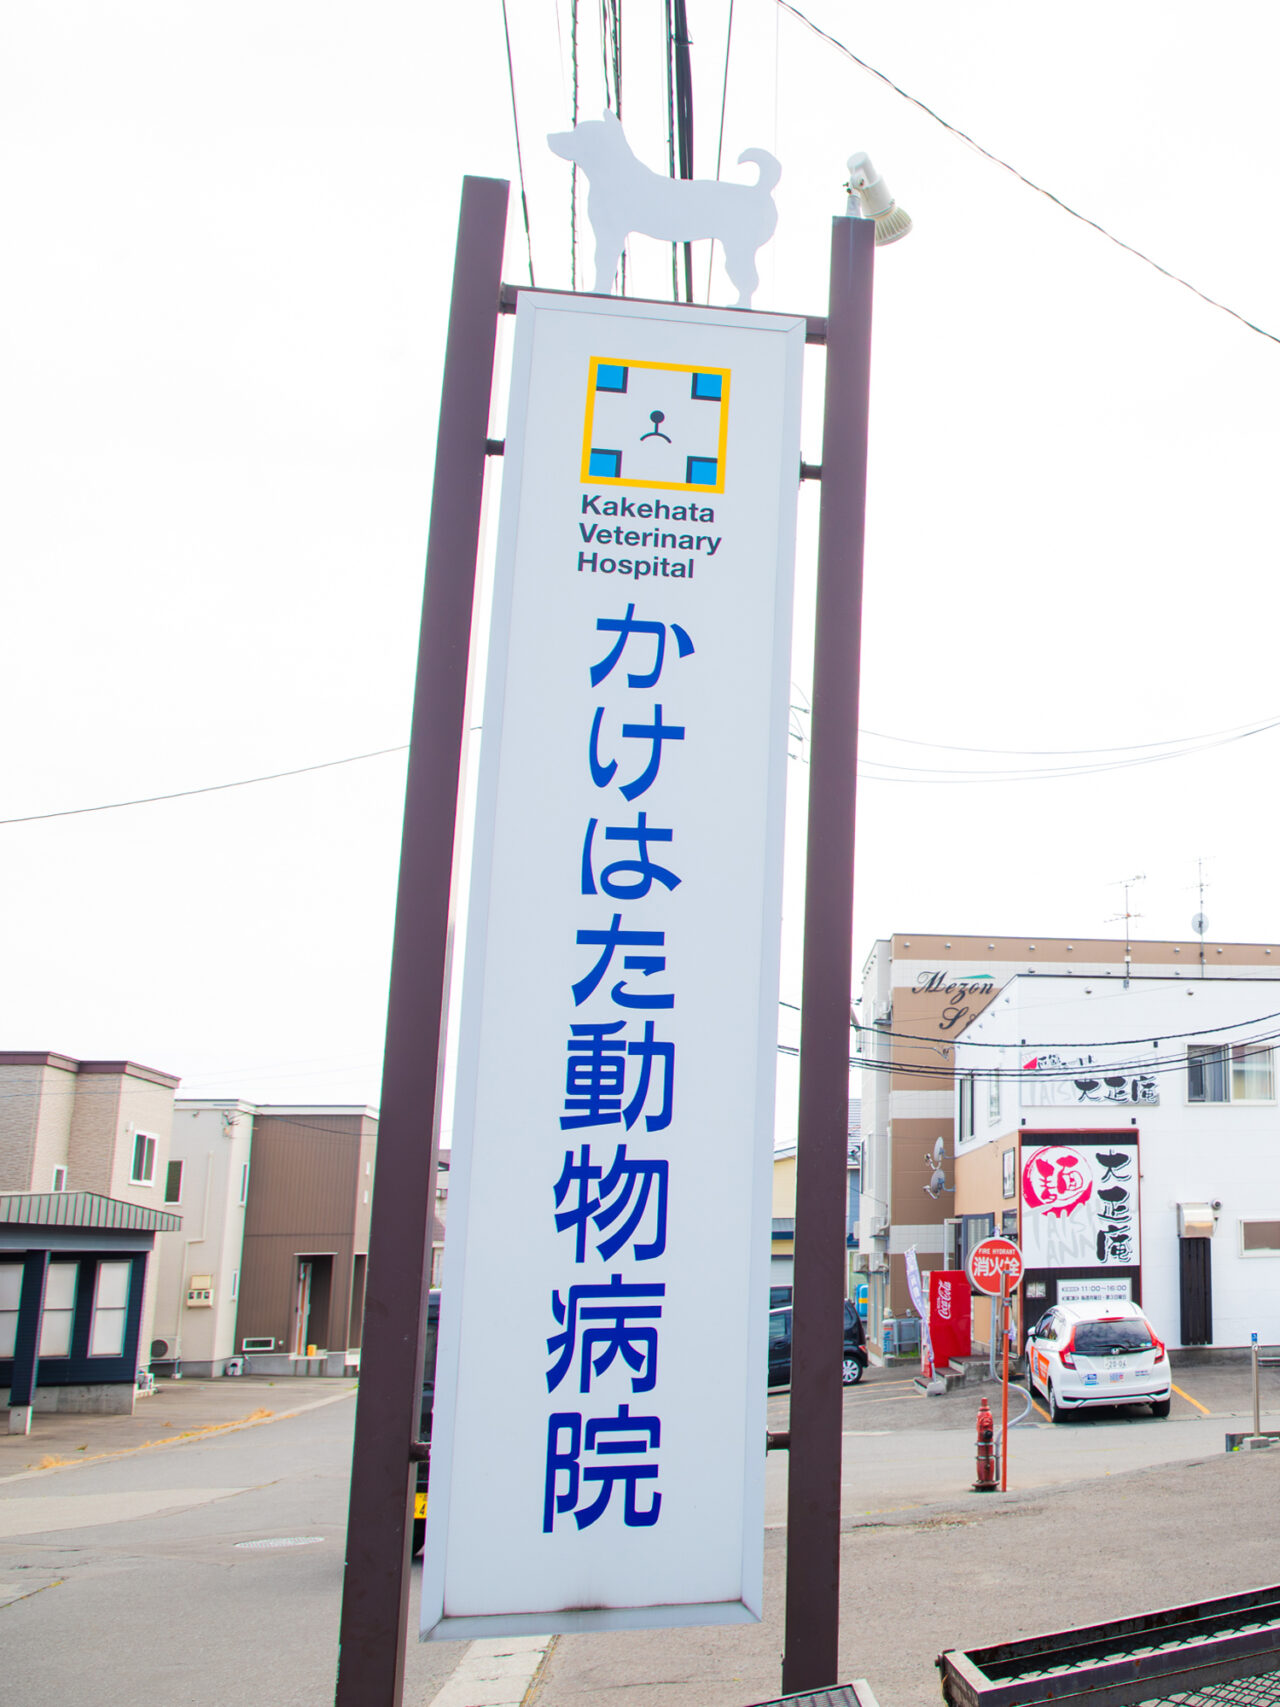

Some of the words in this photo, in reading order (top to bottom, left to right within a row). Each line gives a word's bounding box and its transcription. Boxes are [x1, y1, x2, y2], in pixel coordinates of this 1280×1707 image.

[581, 493, 715, 523] Kakehata
[578, 522, 722, 556] Veterinary
[576, 550, 694, 580] Hospital
[911, 970, 994, 1005] Mezon
[542, 602, 695, 1534] かけはた動物病院
[1095, 1148, 1133, 1264] 大正庵
[974, 1256, 1020, 1277] 消火栓
[978, 1247, 991, 1255] FIRE
